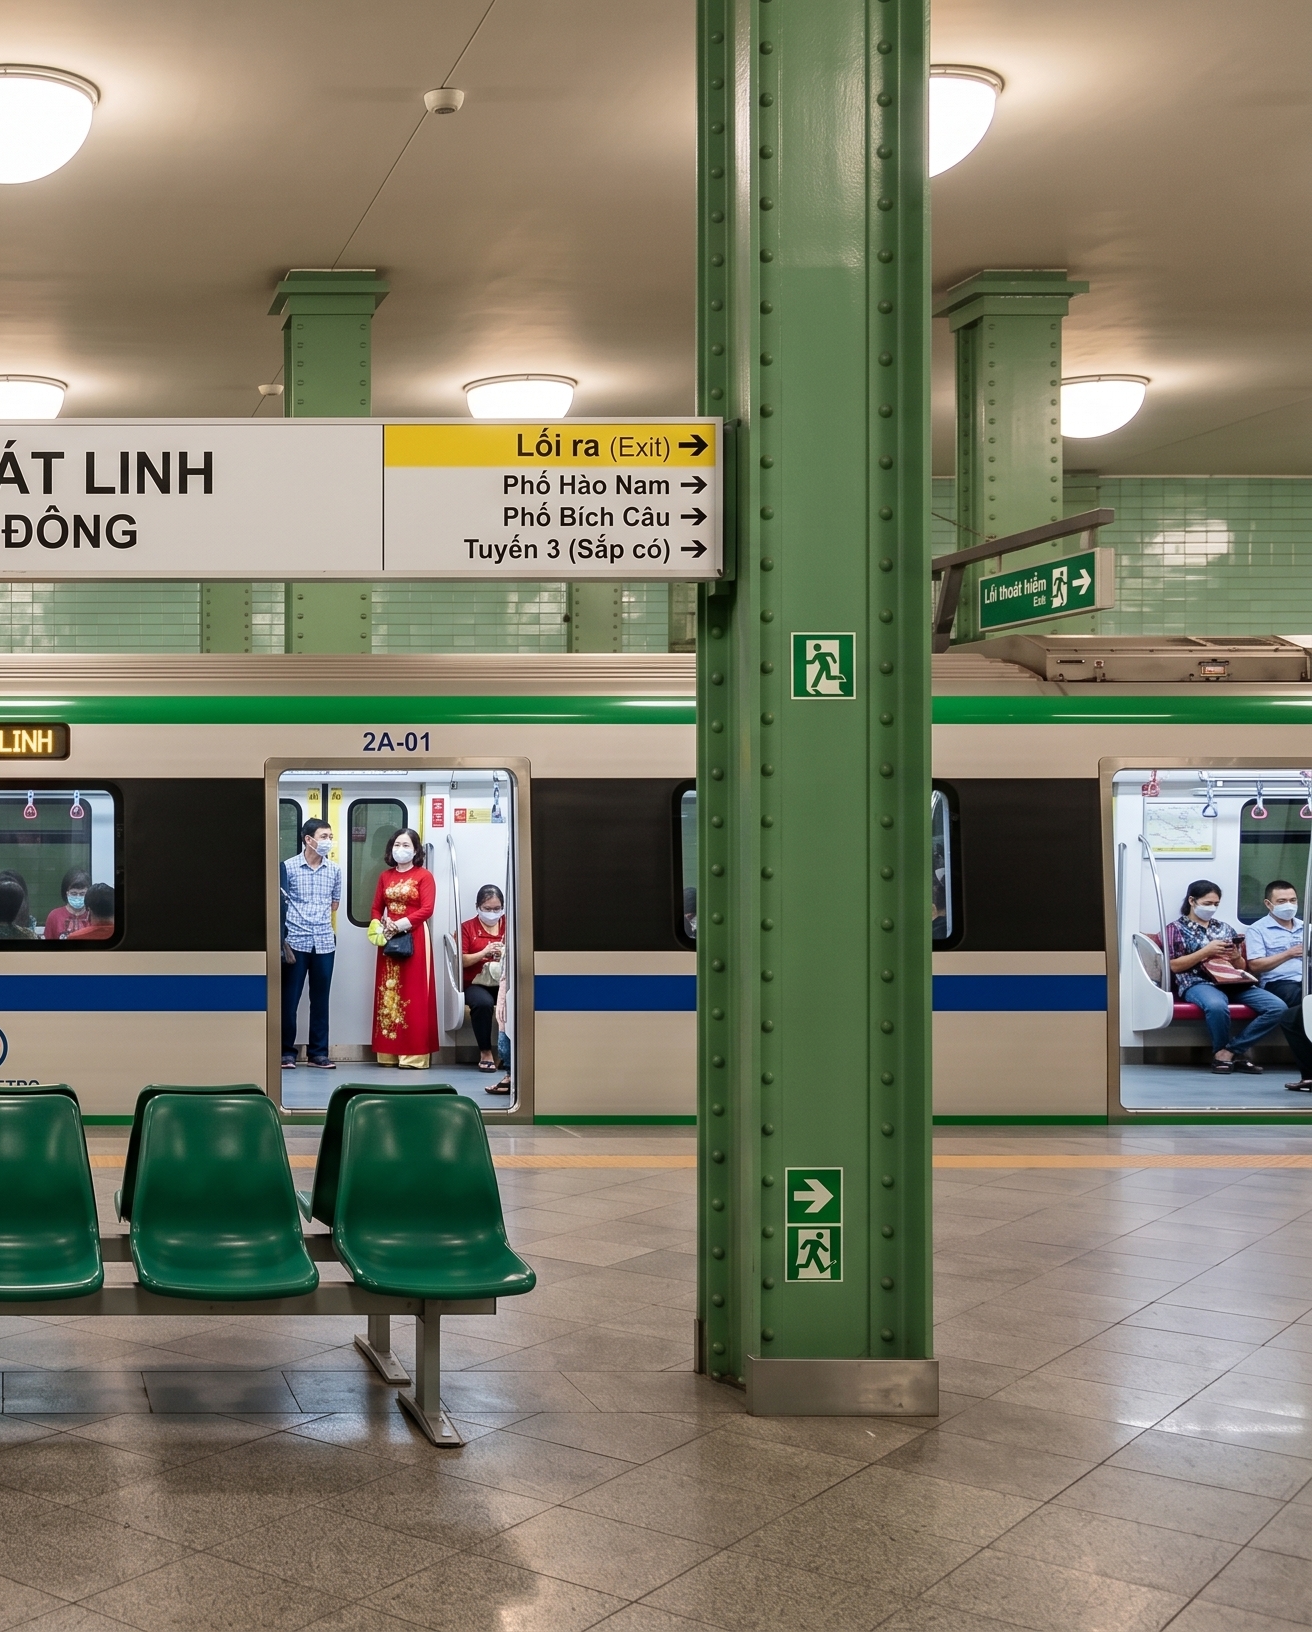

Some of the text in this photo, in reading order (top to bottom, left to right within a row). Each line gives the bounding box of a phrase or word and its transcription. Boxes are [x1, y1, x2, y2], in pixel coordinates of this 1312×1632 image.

[517, 427, 670, 463] Lối ra (Exit)
[85, 451, 213, 495] LINH
[503, 470, 670, 495] Phố Hào Nam
[1, 504, 138, 550] ĐÔNG
[503, 502, 670, 527] Phố Bích Câu
[463, 534, 671, 565] Tuyến 3 (Sắp có)
[362, 731, 431, 752] 2A-01
